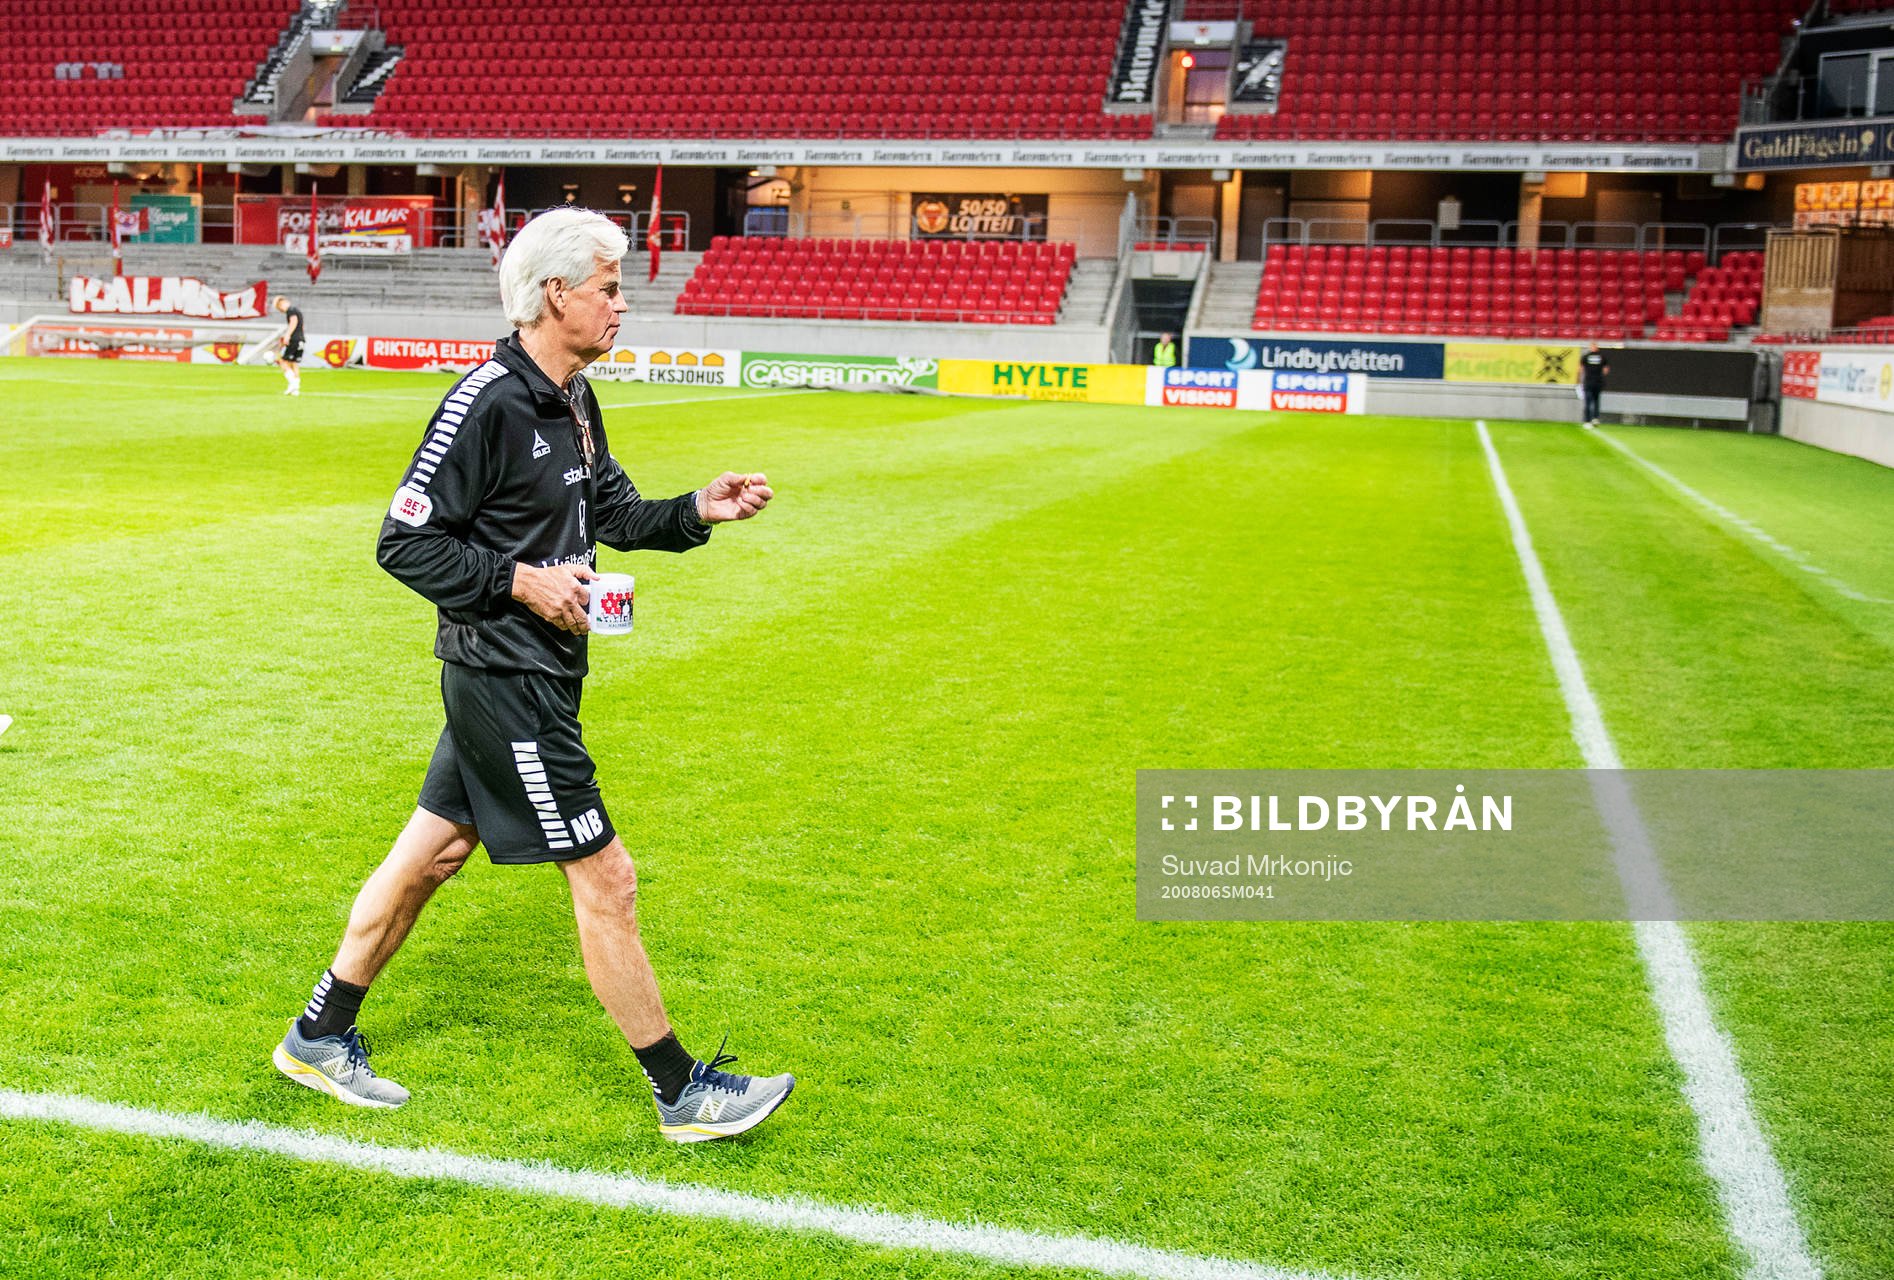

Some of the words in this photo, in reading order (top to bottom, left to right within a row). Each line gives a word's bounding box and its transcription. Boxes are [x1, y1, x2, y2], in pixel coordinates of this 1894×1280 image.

[959, 200, 1007, 216] 50/50
[344, 208, 410, 228] KALMAR
[373, 340, 438, 358] RIKTIGA
[1262, 346, 1404, 373] Lindbytvätten
[749, 363, 911, 387] CASHBUDDY
[994, 364, 1088, 388] HYLTE
[1168, 370, 1235, 388] SPORT
[1276, 374, 1345, 392] SPORT
[1165, 389, 1232, 406] VISION
[1273, 393, 1342, 411] VISION
[404, 497, 428, 514] BET
[570, 808, 604, 845] NB
